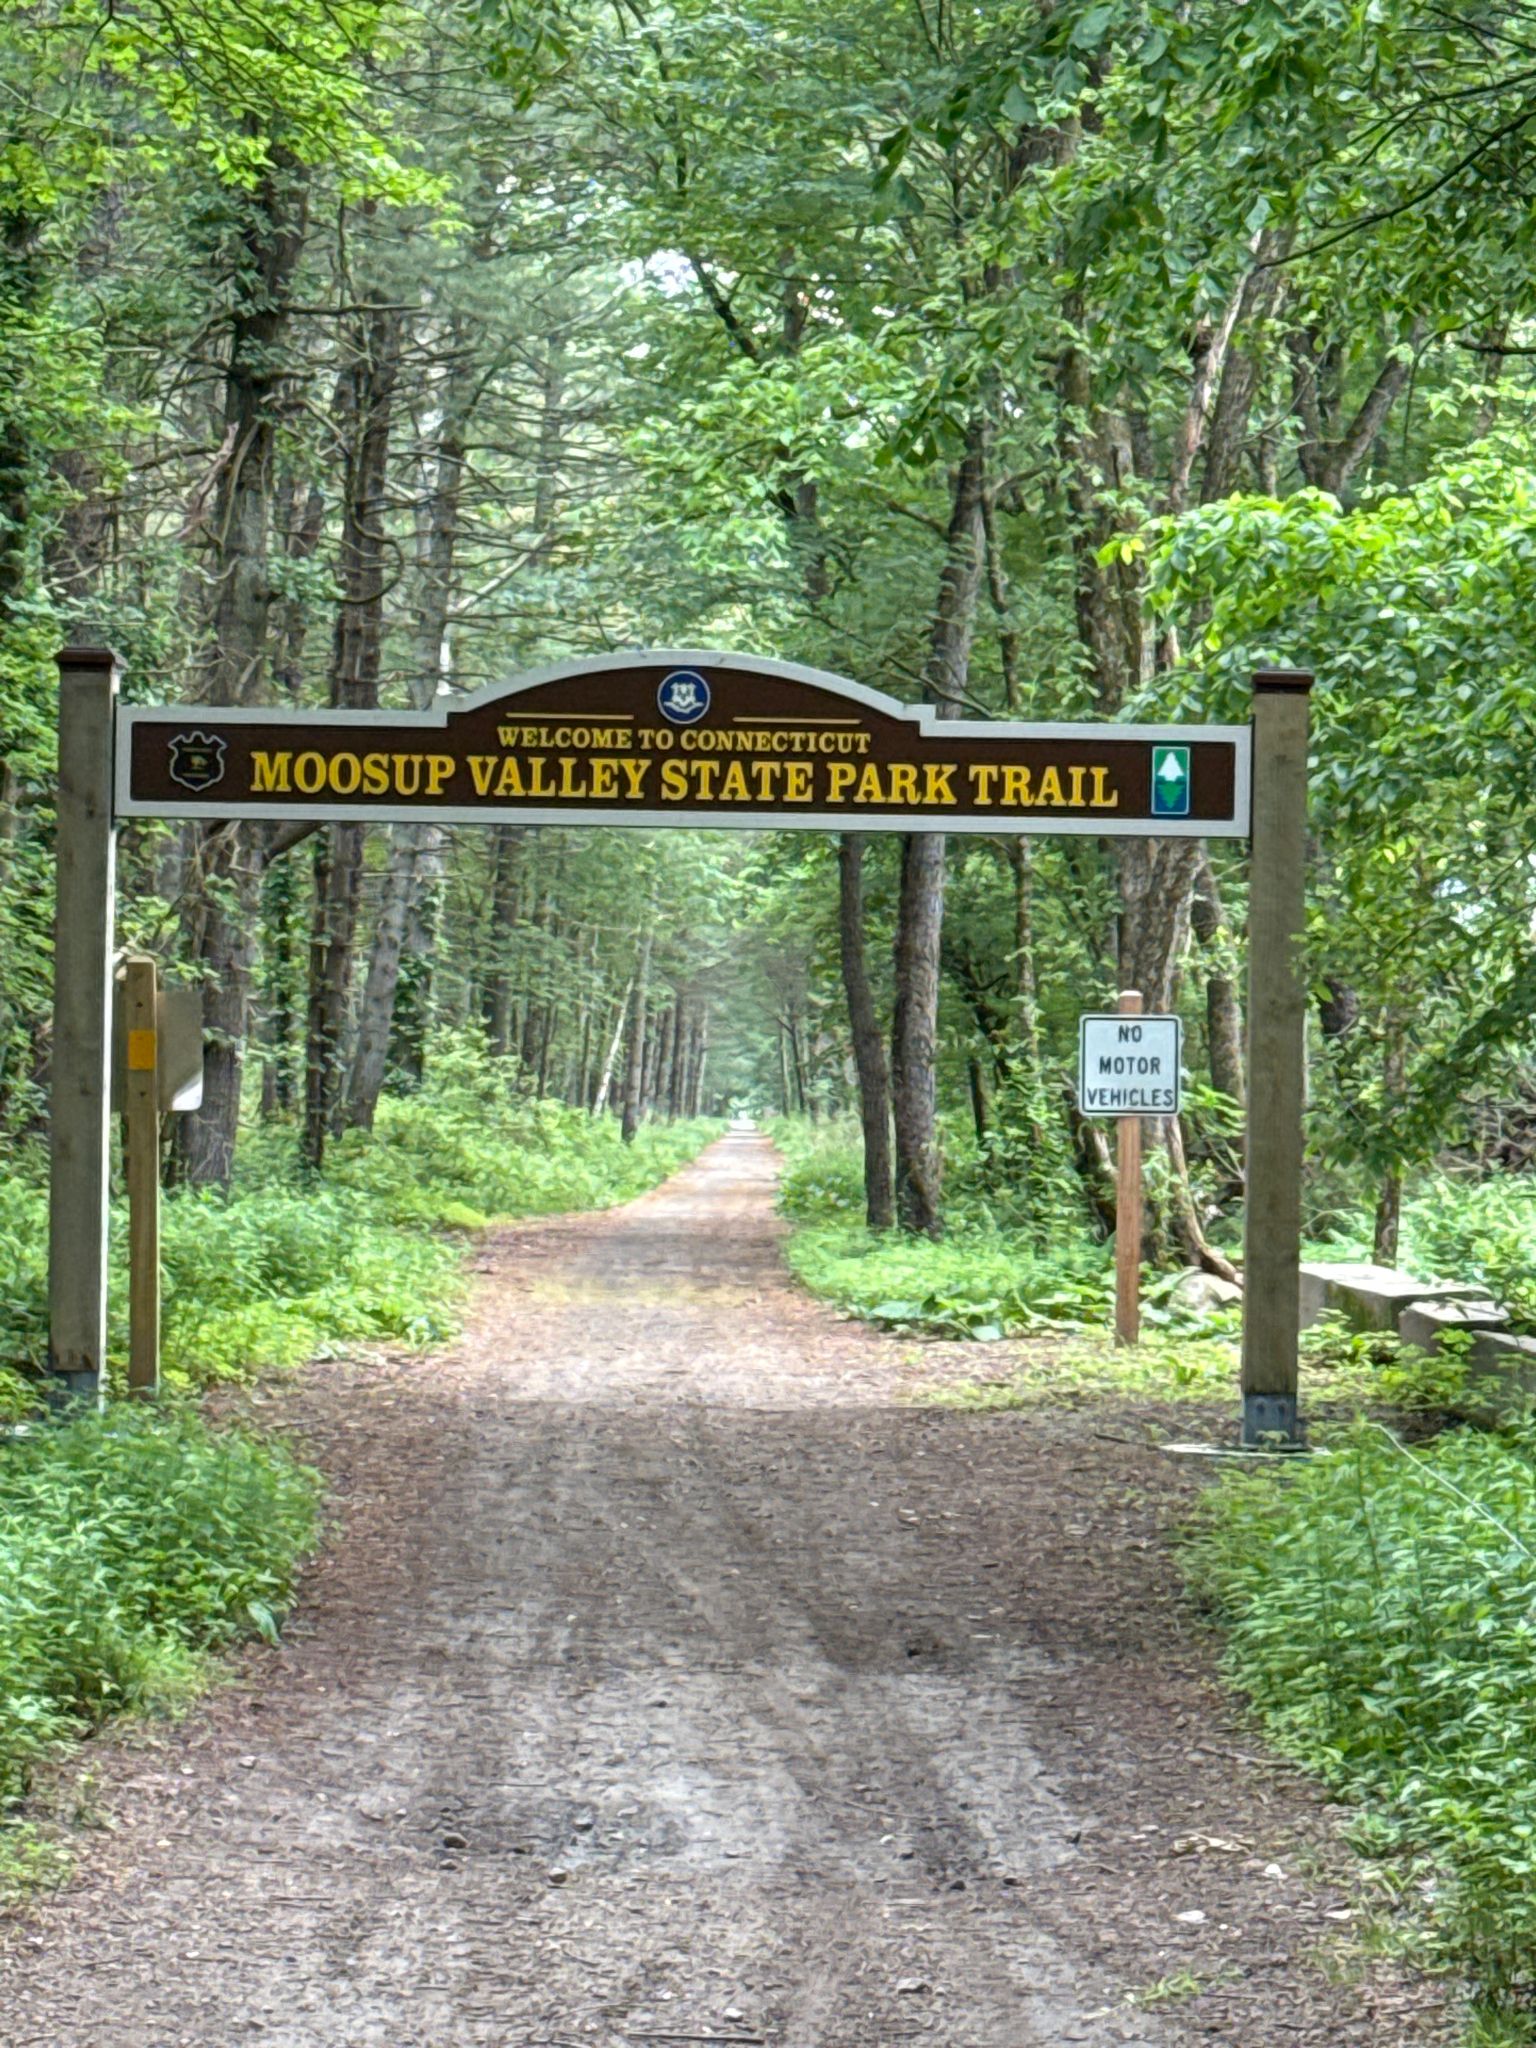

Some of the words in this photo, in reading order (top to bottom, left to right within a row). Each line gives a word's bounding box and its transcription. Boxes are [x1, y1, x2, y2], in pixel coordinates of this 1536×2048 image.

[497, 725, 633, 750] WELCOME
[638, 728, 671, 751] TO
[680, 729, 871, 754] CONNECTICUT
[249, 751, 455, 796] MOOSUP
[465, 755, 652, 800] VALLEY
[660, 760, 814, 803] STATE
[826, 763, 958, 806] PARK
[969, 764, 1119, 808] TRAIL
[1118, 1024, 1142, 1042] NO
[1099, 1055, 1160, 1075] MOTOR
[1087, 1087, 1174, 1107] VEHICLES
